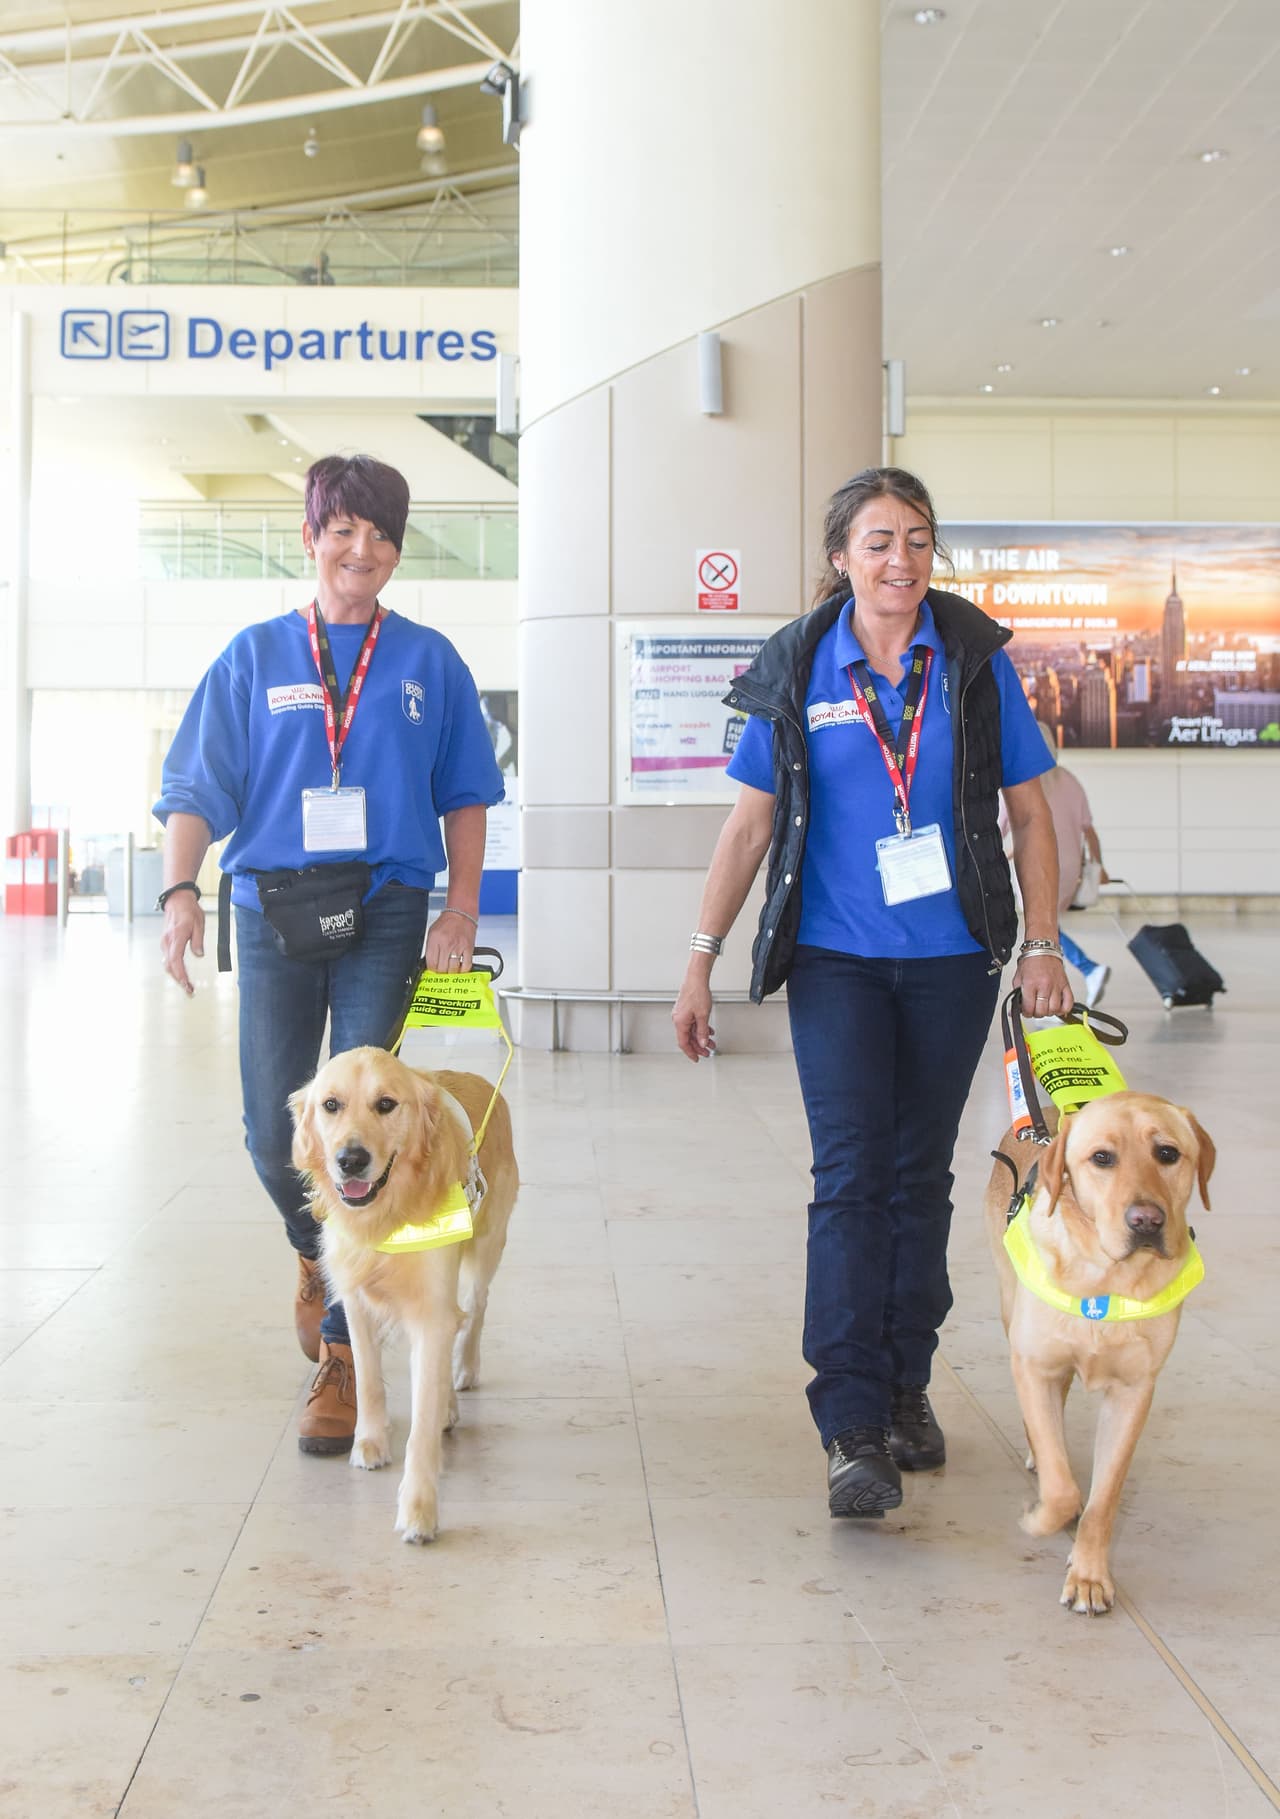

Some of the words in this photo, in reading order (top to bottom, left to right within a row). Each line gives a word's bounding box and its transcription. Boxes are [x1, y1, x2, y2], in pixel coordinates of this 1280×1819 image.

[187, 317, 498, 370] Departures
[953, 549, 974, 571] IN
[980, 549, 1020, 571] THE
[1024, 549, 1060, 571] AIR
[993, 583, 1108, 605] DOWNTOWN
[646, 644, 703, 655] IMPORTANT
[704, 644, 761, 655] INFORMATI
[650, 664, 692, 673] AIRPORT
[271, 694, 297, 705] ROYAL
[691, 690, 727, 698] LUGGAG
[343, 705, 354, 729] VISITOR
[810, 711, 836, 725] ROYAL
[838, 709, 861, 719] CANI
[1168, 725, 1200, 742] Aer
[1201, 725, 1257, 747] Lingus
[908, 732, 918, 758] VISITOR
[882, 744, 895, 771] VISITOR
[319, 913, 345, 926] karen
[321, 920, 346, 933] pryor
[452, 976, 477, 984] don't
[410, 1006, 437, 1014] guide
[438, 1008, 463, 1017] dog!
[438, 999, 478, 1009] working
[1031, 1048, 1054, 1063] ease
[1056, 1045, 1083, 1053] don't
[1035, 1056, 1065, 1072] stract
[1060, 1068, 1104, 1076] working
[1047, 1078, 1070, 1093] uide
[1072, 1078, 1097, 1086] dog!
